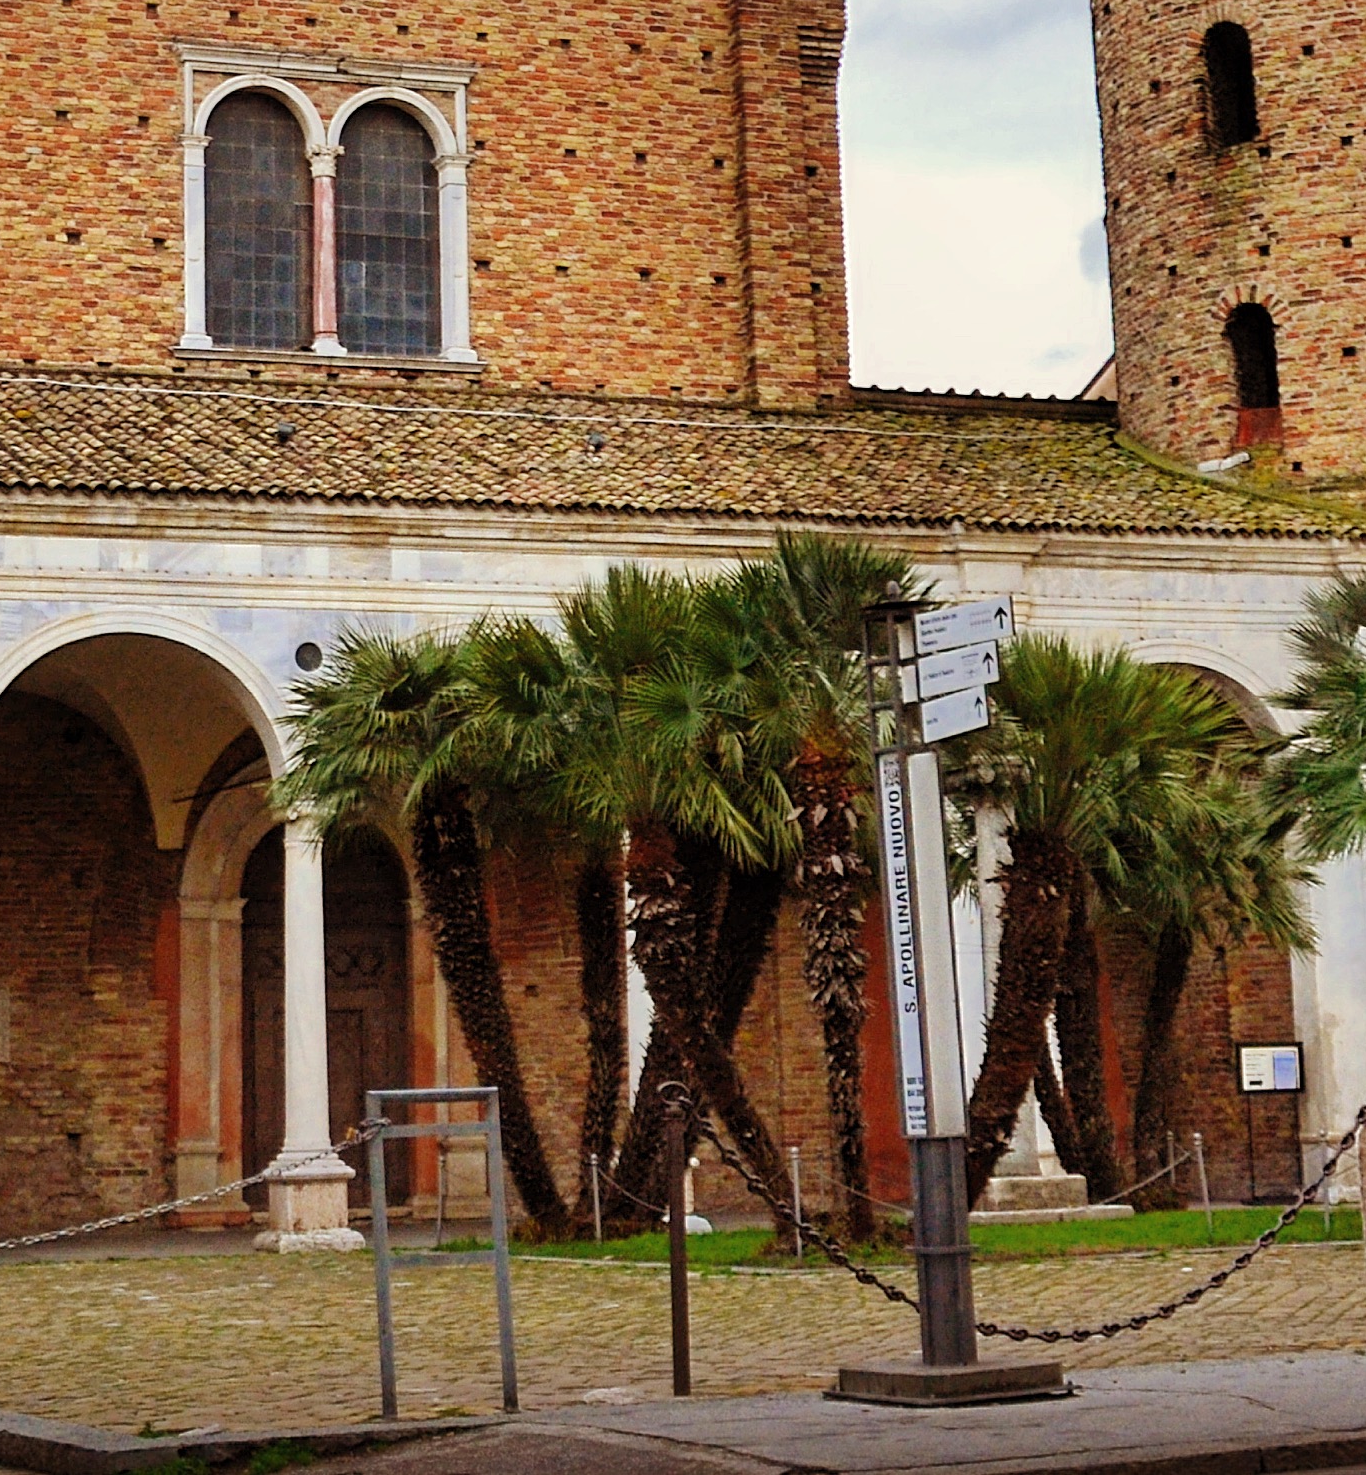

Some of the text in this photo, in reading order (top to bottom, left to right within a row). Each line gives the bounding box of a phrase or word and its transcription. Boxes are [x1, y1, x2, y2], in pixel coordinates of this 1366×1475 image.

[888, 790, 917, 1013] S. APOLLINARE NUOVO
